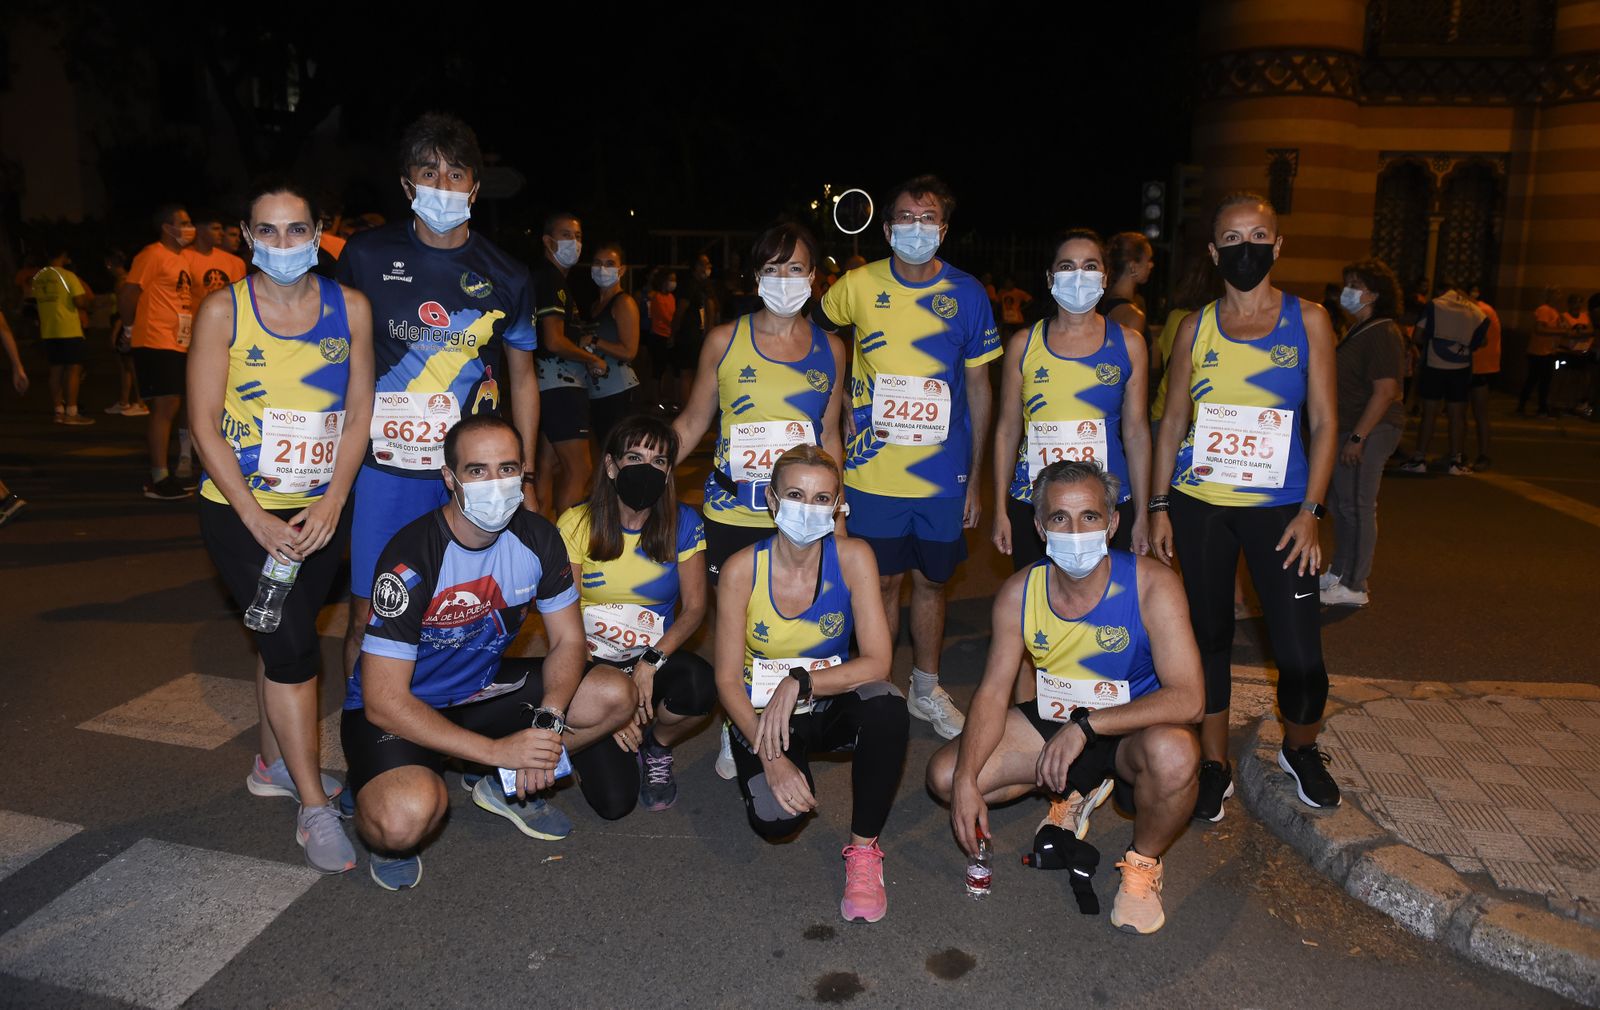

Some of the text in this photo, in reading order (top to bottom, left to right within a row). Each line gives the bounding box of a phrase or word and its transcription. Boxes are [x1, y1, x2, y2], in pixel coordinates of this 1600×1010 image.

[883, 400, 938, 422] 2429
[383, 420, 447, 442] 6623
[874, 420, 894, 428] MANUEL
[274, 440, 334, 465] 2198
[1206, 432, 1274, 460] 2355
[294, 467, 321, 475] CASTAÑO
[454, 611, 464, 620] LA
[594, 621, 651, 648] 2293
